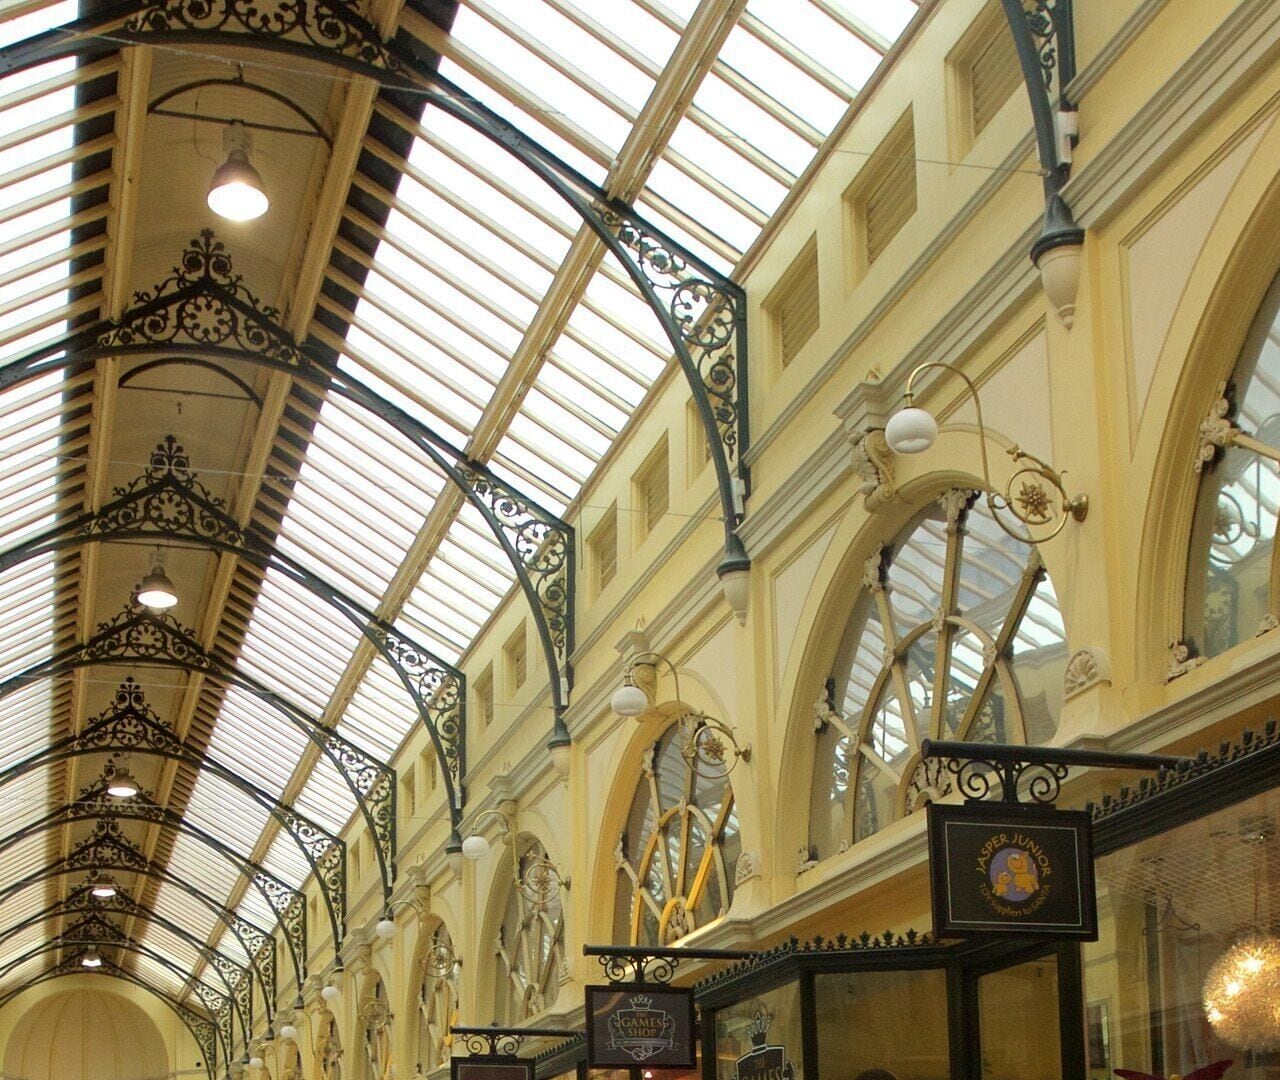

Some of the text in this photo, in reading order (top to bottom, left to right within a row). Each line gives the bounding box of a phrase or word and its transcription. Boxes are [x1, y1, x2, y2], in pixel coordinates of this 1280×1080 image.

[975, 833, 1051, 877] JASPER JUNIOR
[621, 1017, 663, 1028] GAMES
[628, 1028, 658, 1038] SHOP
